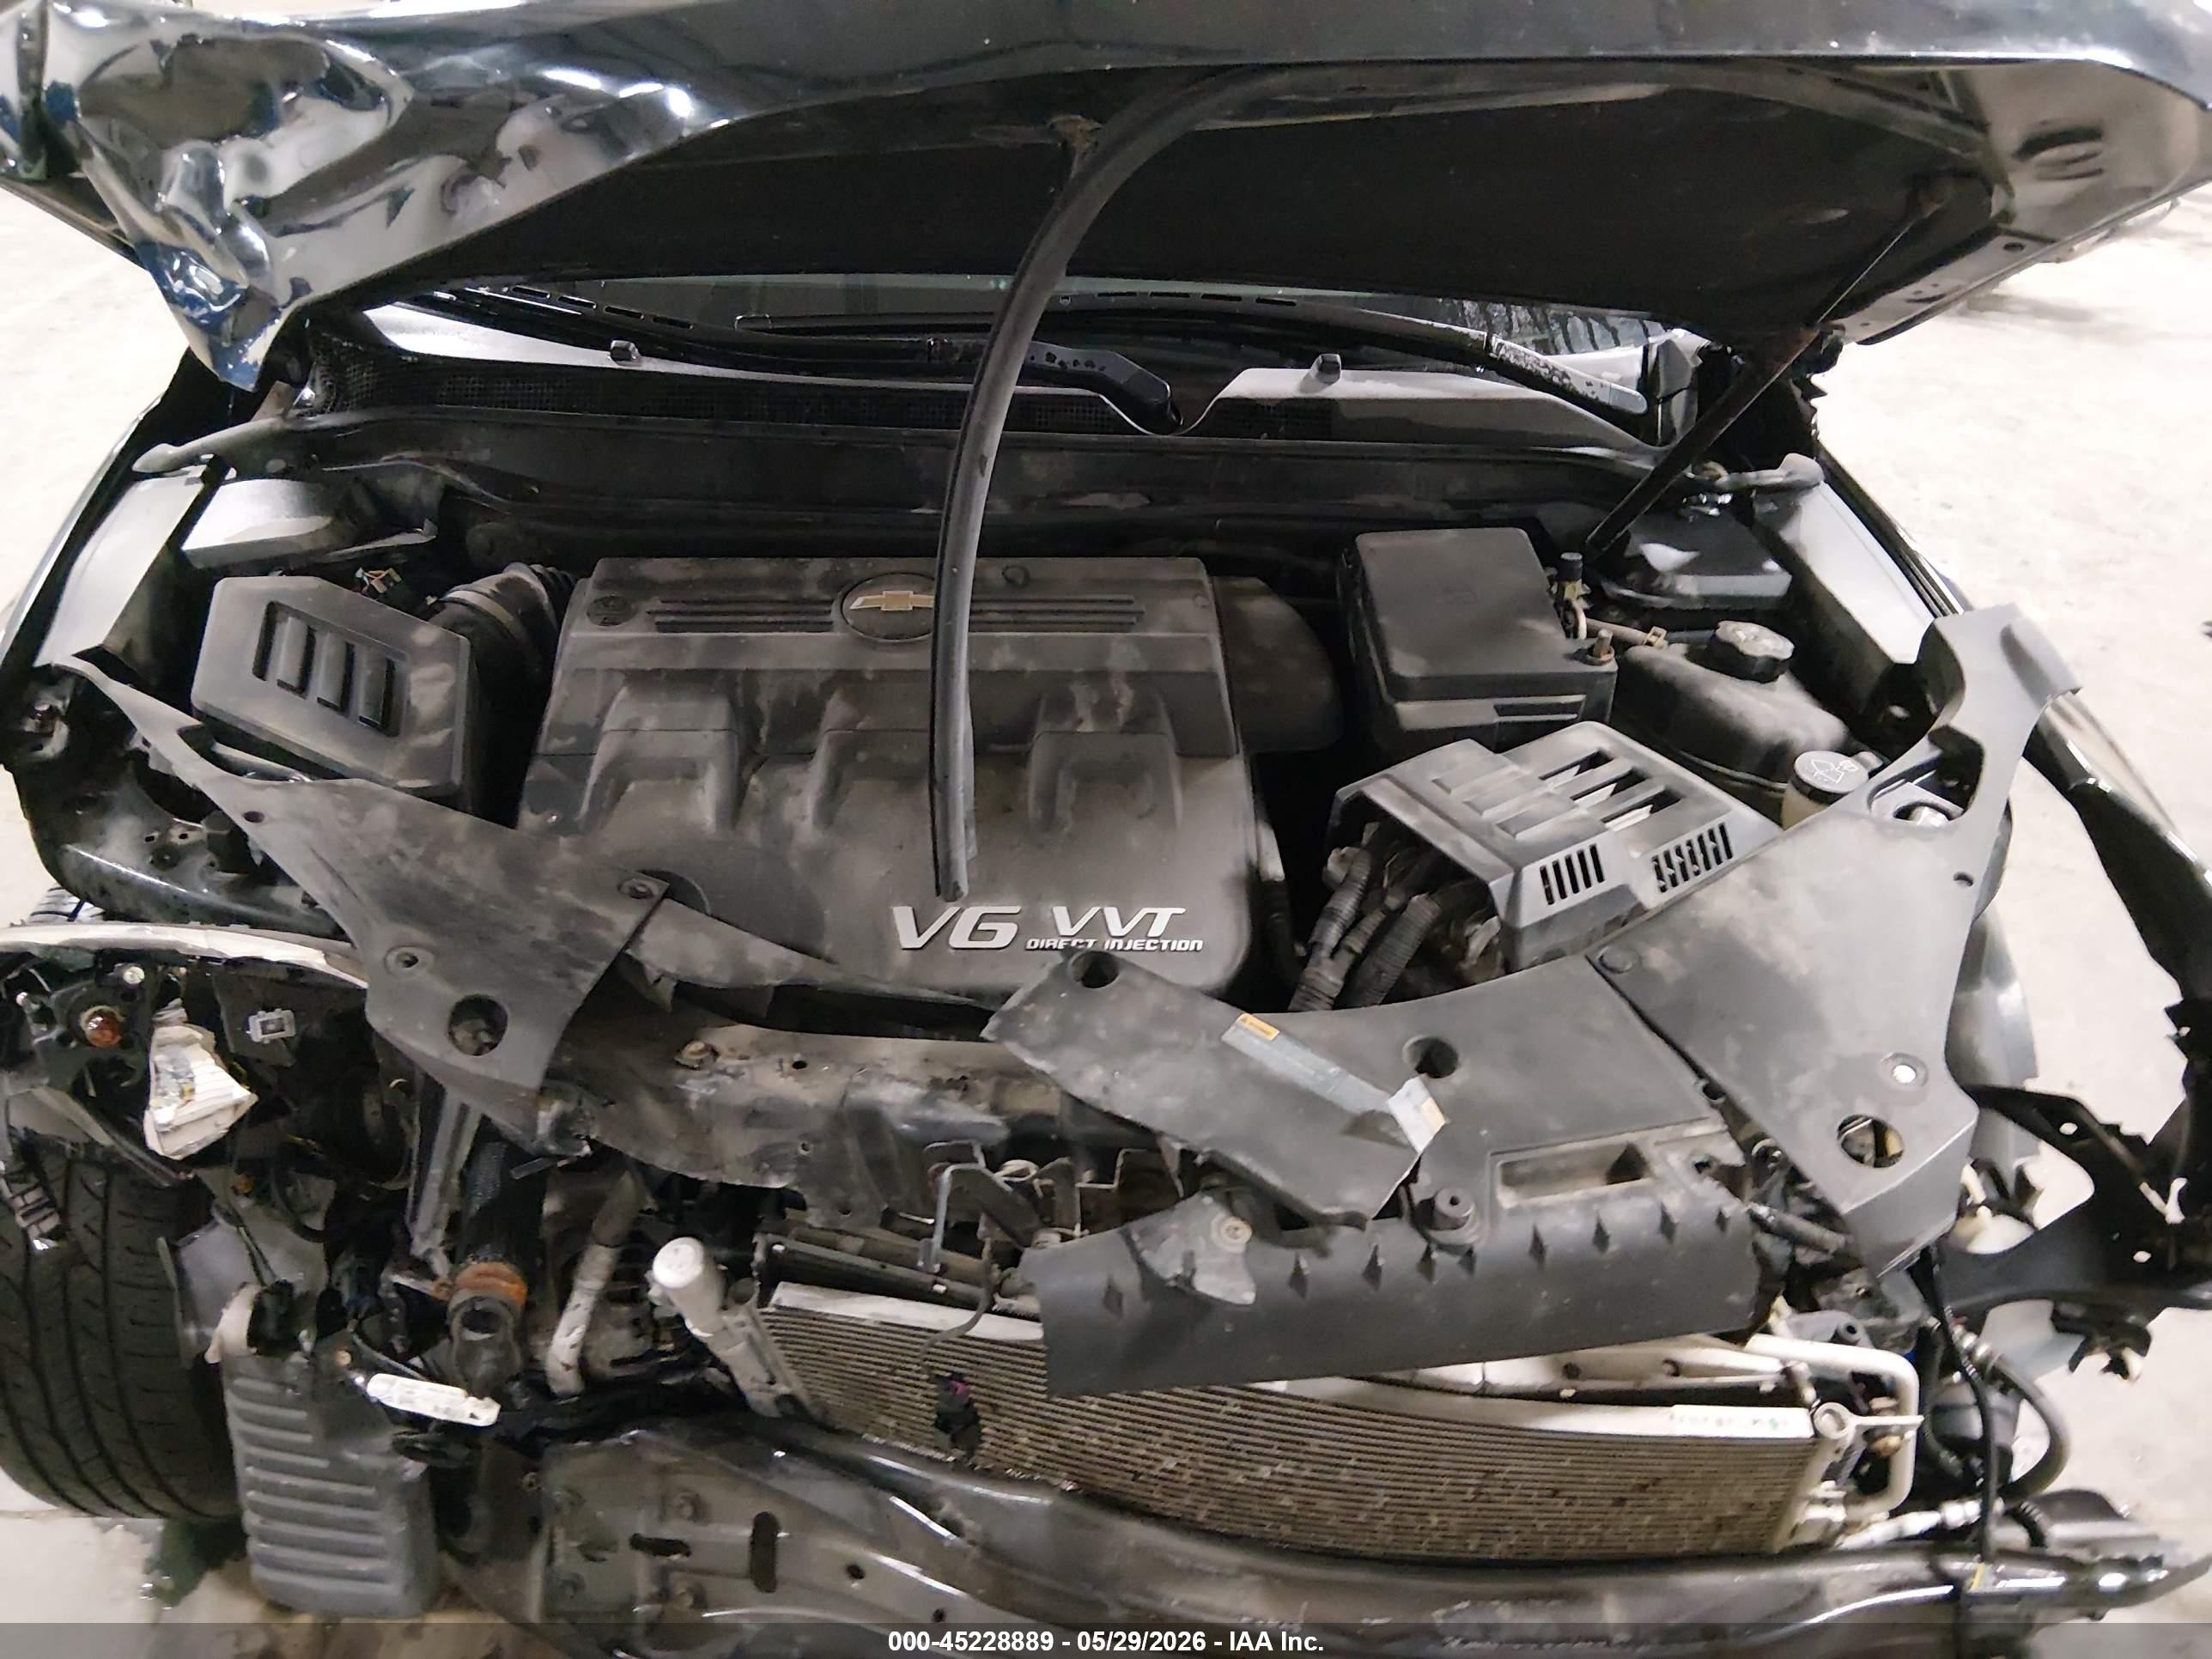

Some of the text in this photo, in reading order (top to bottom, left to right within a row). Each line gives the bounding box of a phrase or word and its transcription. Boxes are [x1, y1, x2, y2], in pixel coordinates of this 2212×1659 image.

[893, 906, 1187, 949] V6 VVT
[1103, 939, 1203, 951] INJECTION
